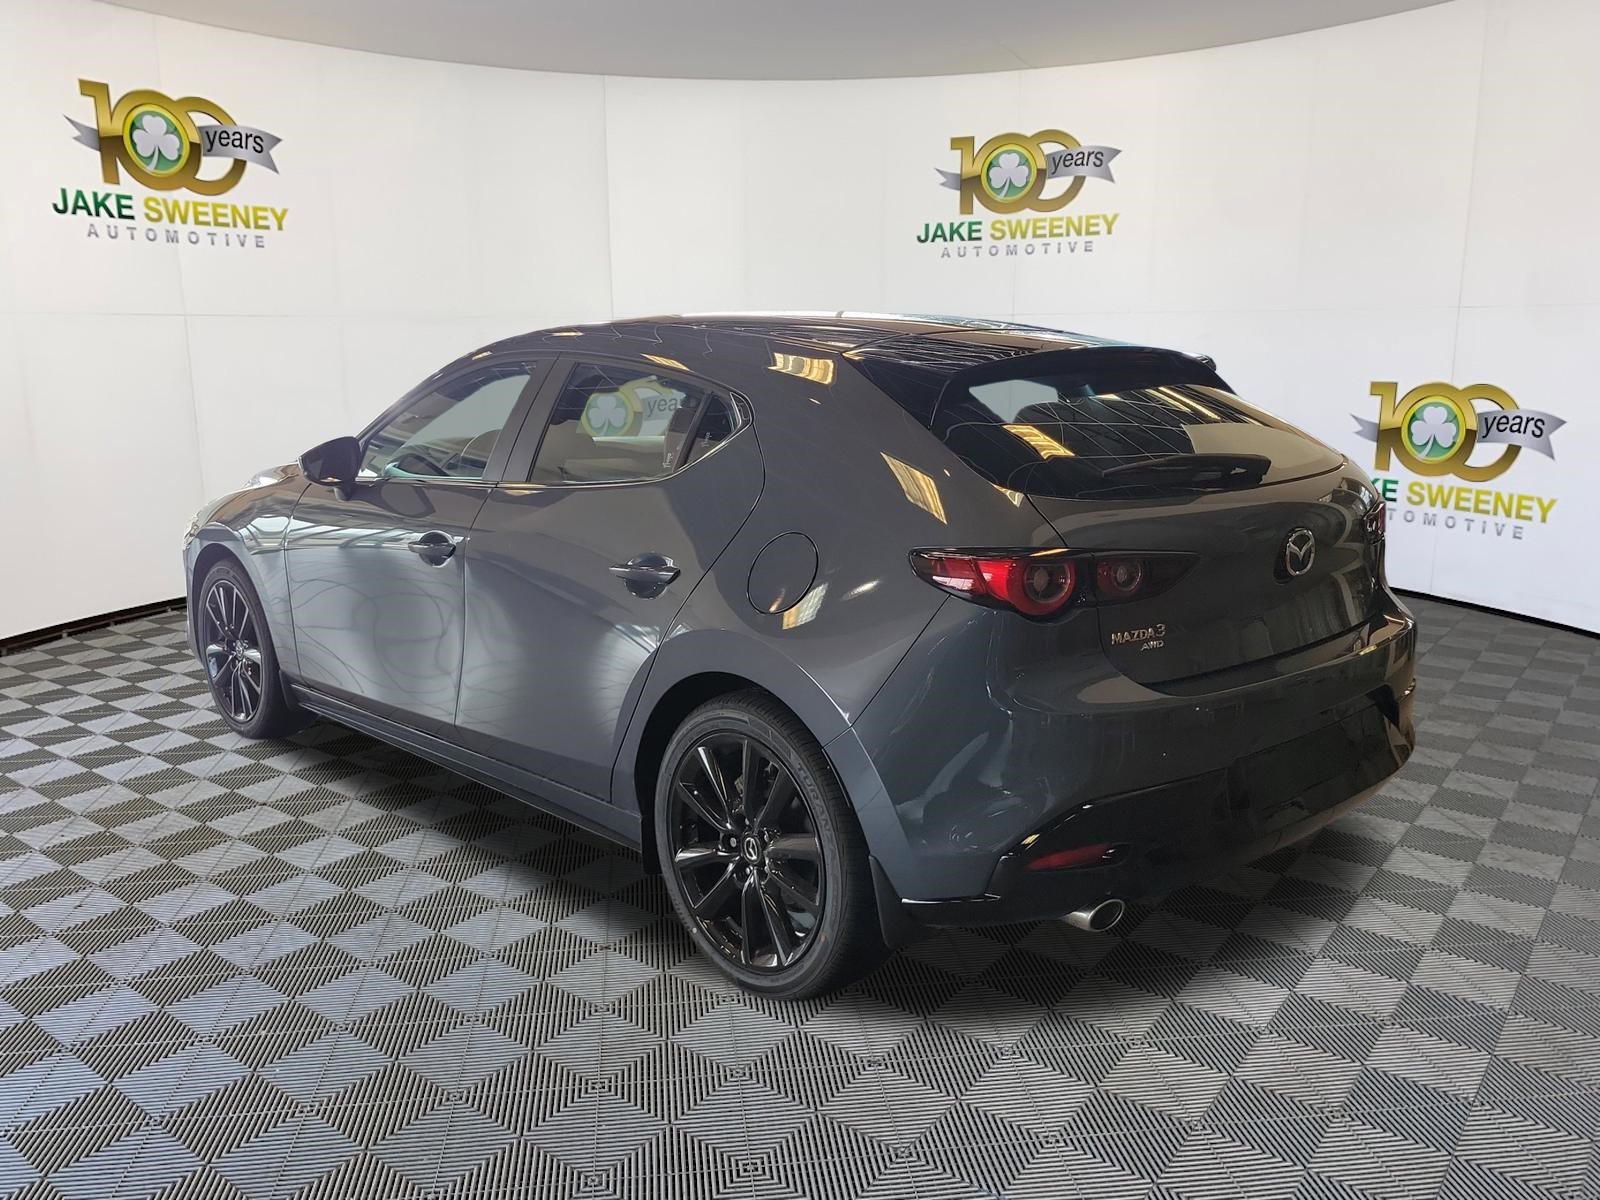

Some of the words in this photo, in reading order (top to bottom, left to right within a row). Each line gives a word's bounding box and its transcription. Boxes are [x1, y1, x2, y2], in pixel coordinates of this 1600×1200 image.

[205, 129, 264, 154] years
[1051, 150, 1104, 174] years
[52, 187, 135, 220] JAKE
[143, 196, 289, 231] SWEENEY
[87, 223, 265, 248] AUTOMOTIVE
[916, 220, 983, 243] JAKE
[990, 213, 1120, 240] SWEENEY
[940, 241, 1094, 258] AUTOMOTIVE
[1482, 414, 1545, 439] years
[1406, 480, 1558, 524] SWEENEY
[1387, 507, 1524, 540] TOMOTIVE
[1141, 640, 1164, 651] AWD
